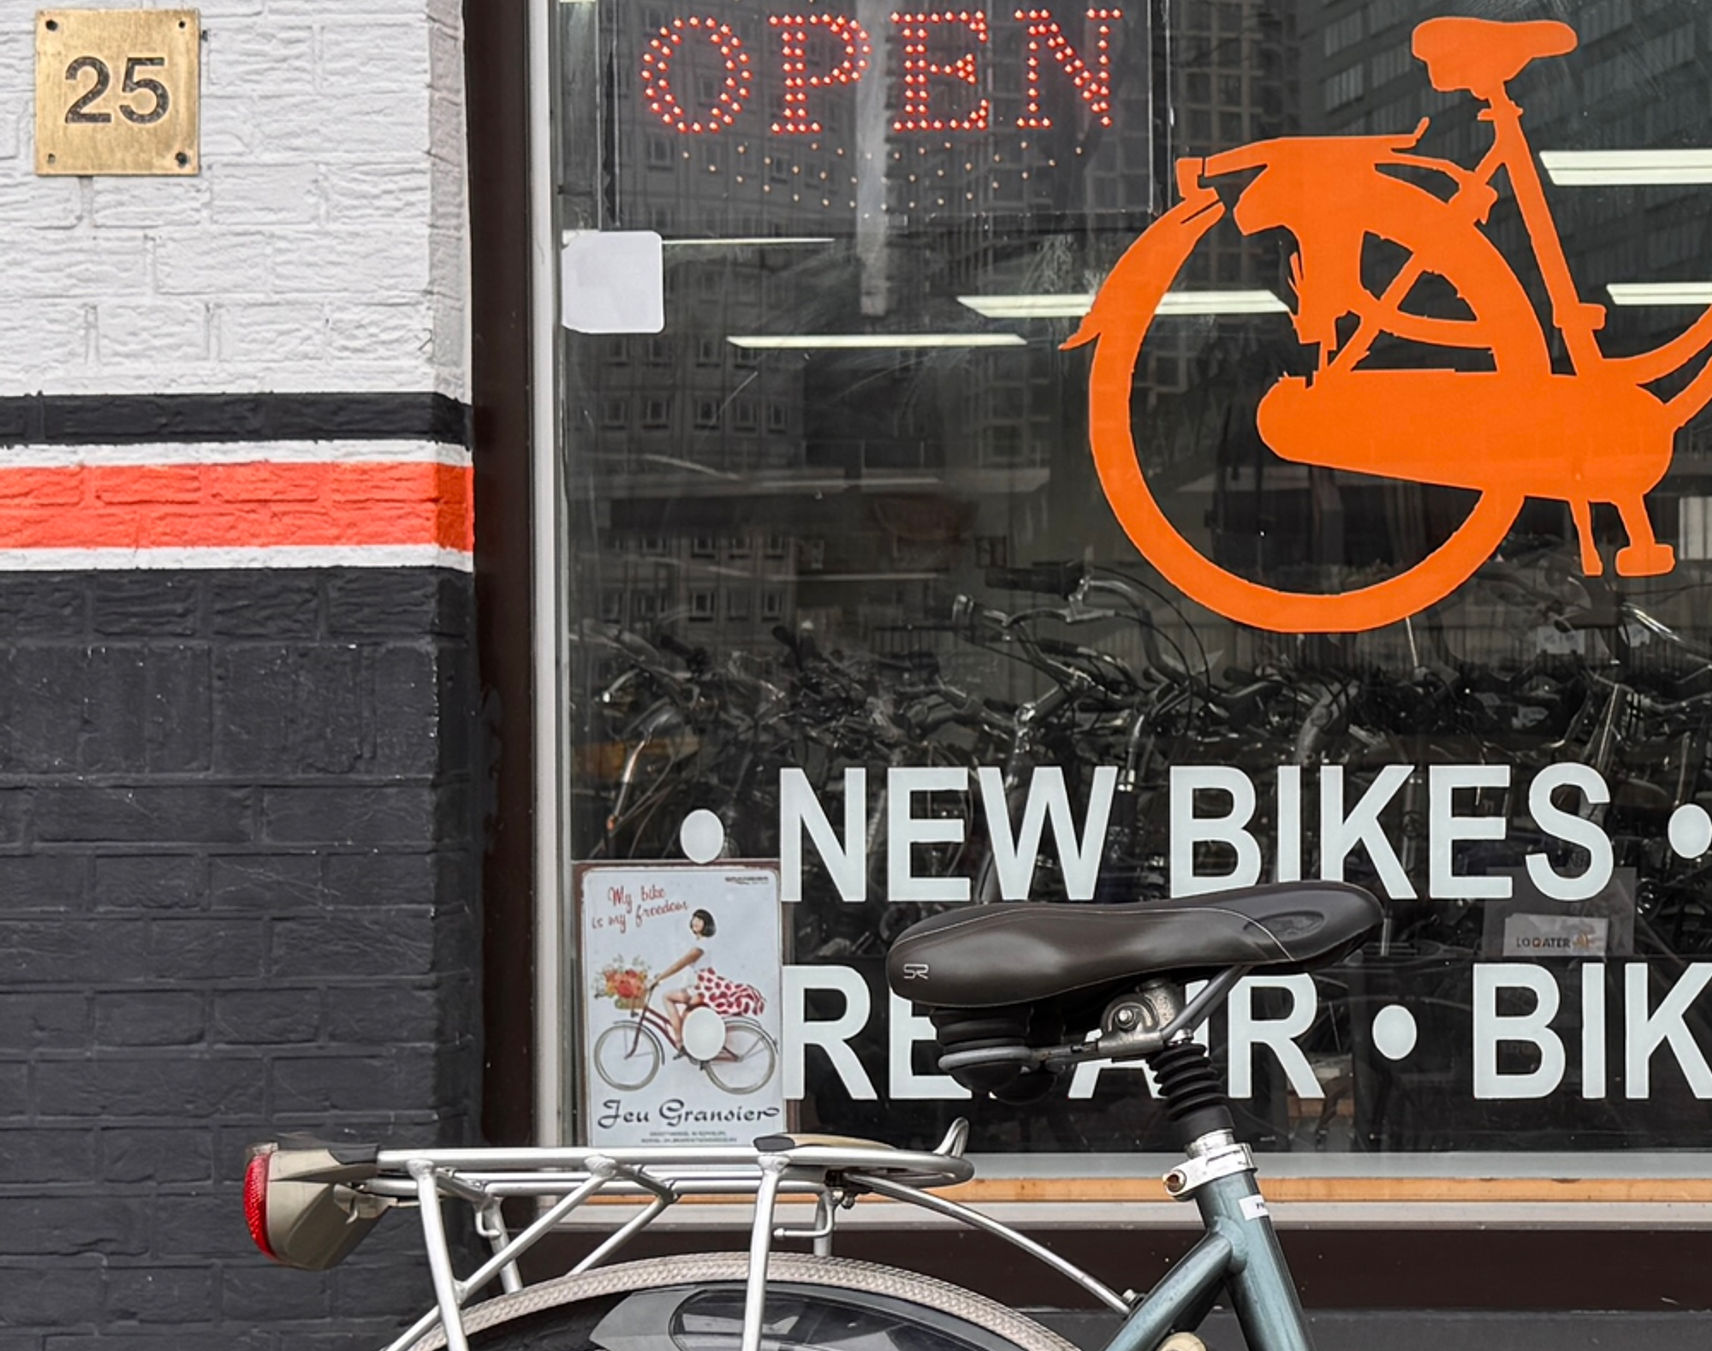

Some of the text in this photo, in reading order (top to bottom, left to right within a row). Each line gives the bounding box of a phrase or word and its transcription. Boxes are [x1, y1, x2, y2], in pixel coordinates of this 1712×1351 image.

[65, 56, 170, 124] 25
[641, 8, 1123, 132] OPEN
[780, 765, 1119, 903] NEW
[1169, 762, 1615, 902] BIKES
[592, 900, 689, 933] is my freedom
[609, 884, 667, 914] My bike
